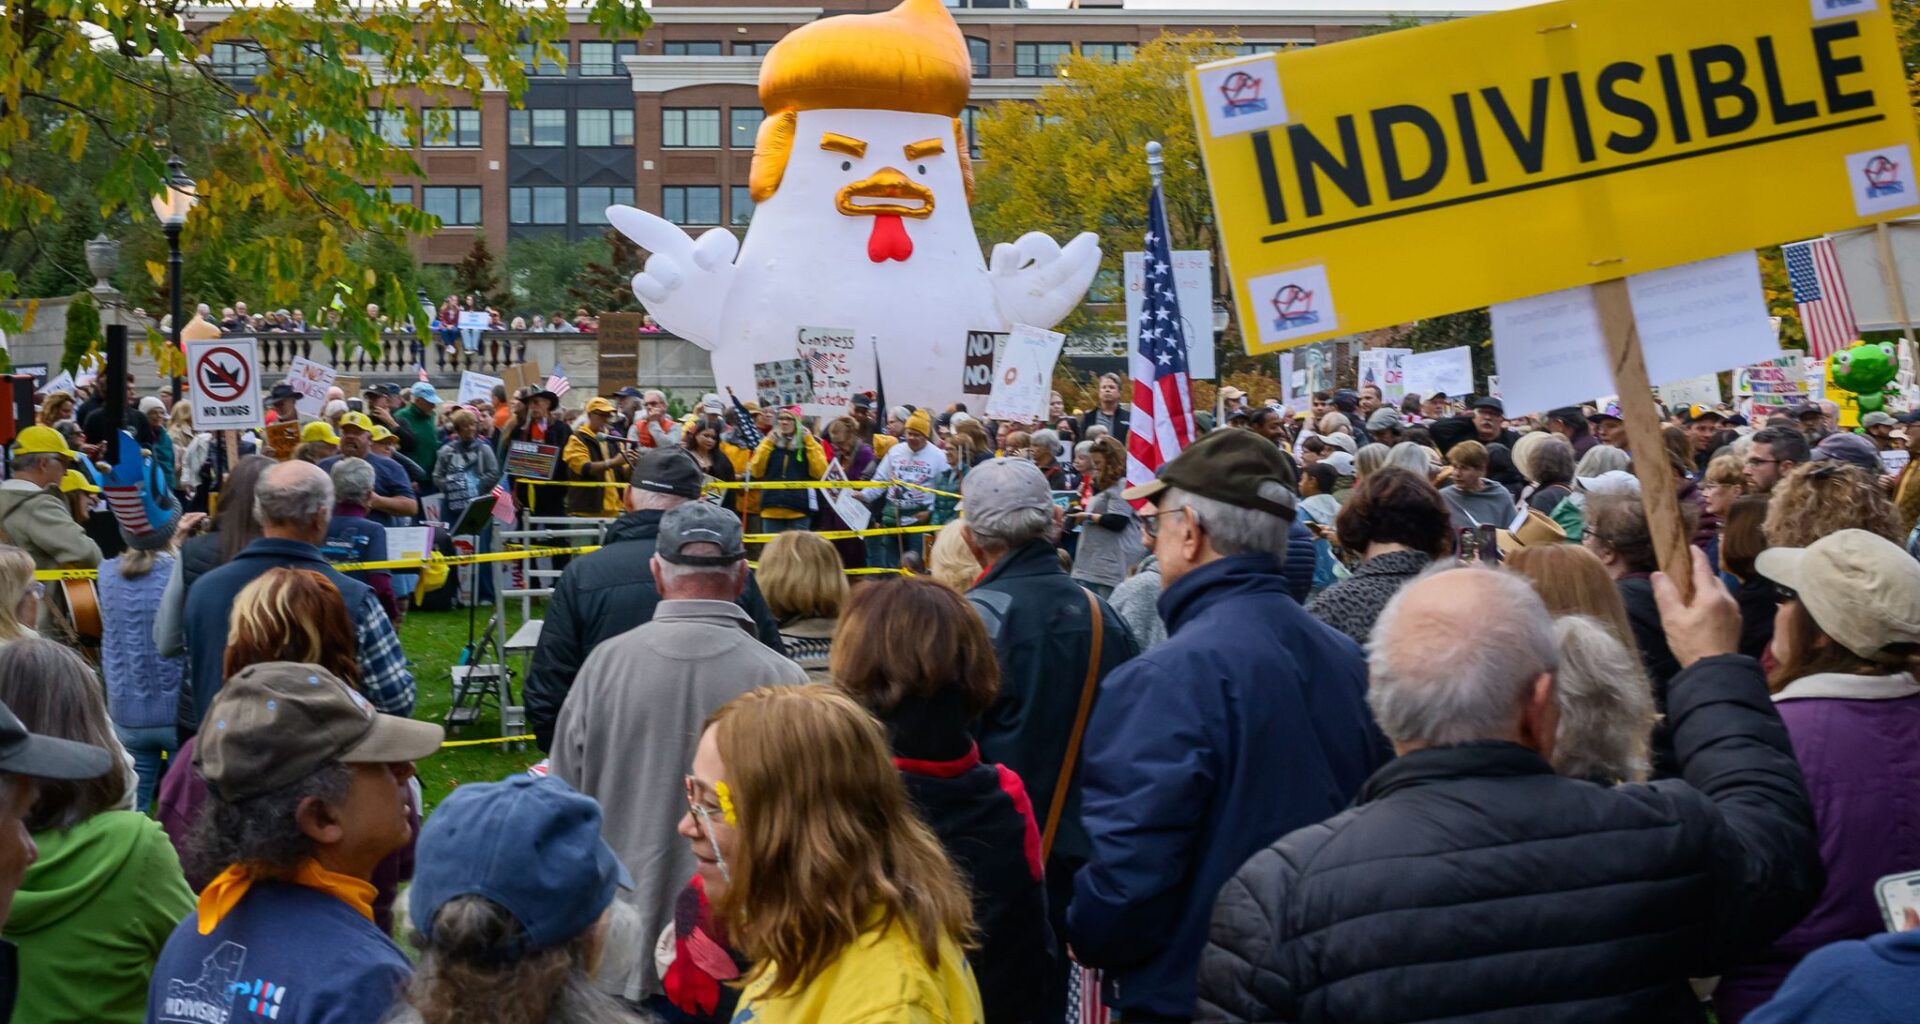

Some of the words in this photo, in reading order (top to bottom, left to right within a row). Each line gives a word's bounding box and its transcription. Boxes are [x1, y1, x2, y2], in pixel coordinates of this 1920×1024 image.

[1251, 20, 1875, 225] INDIVISIBLE
[798, 328, 854, 349] Congress
[968, 333, 994, 357] NO
[203, 406, 217, 417] NO
[220, 405, 250, 416] KINGS
